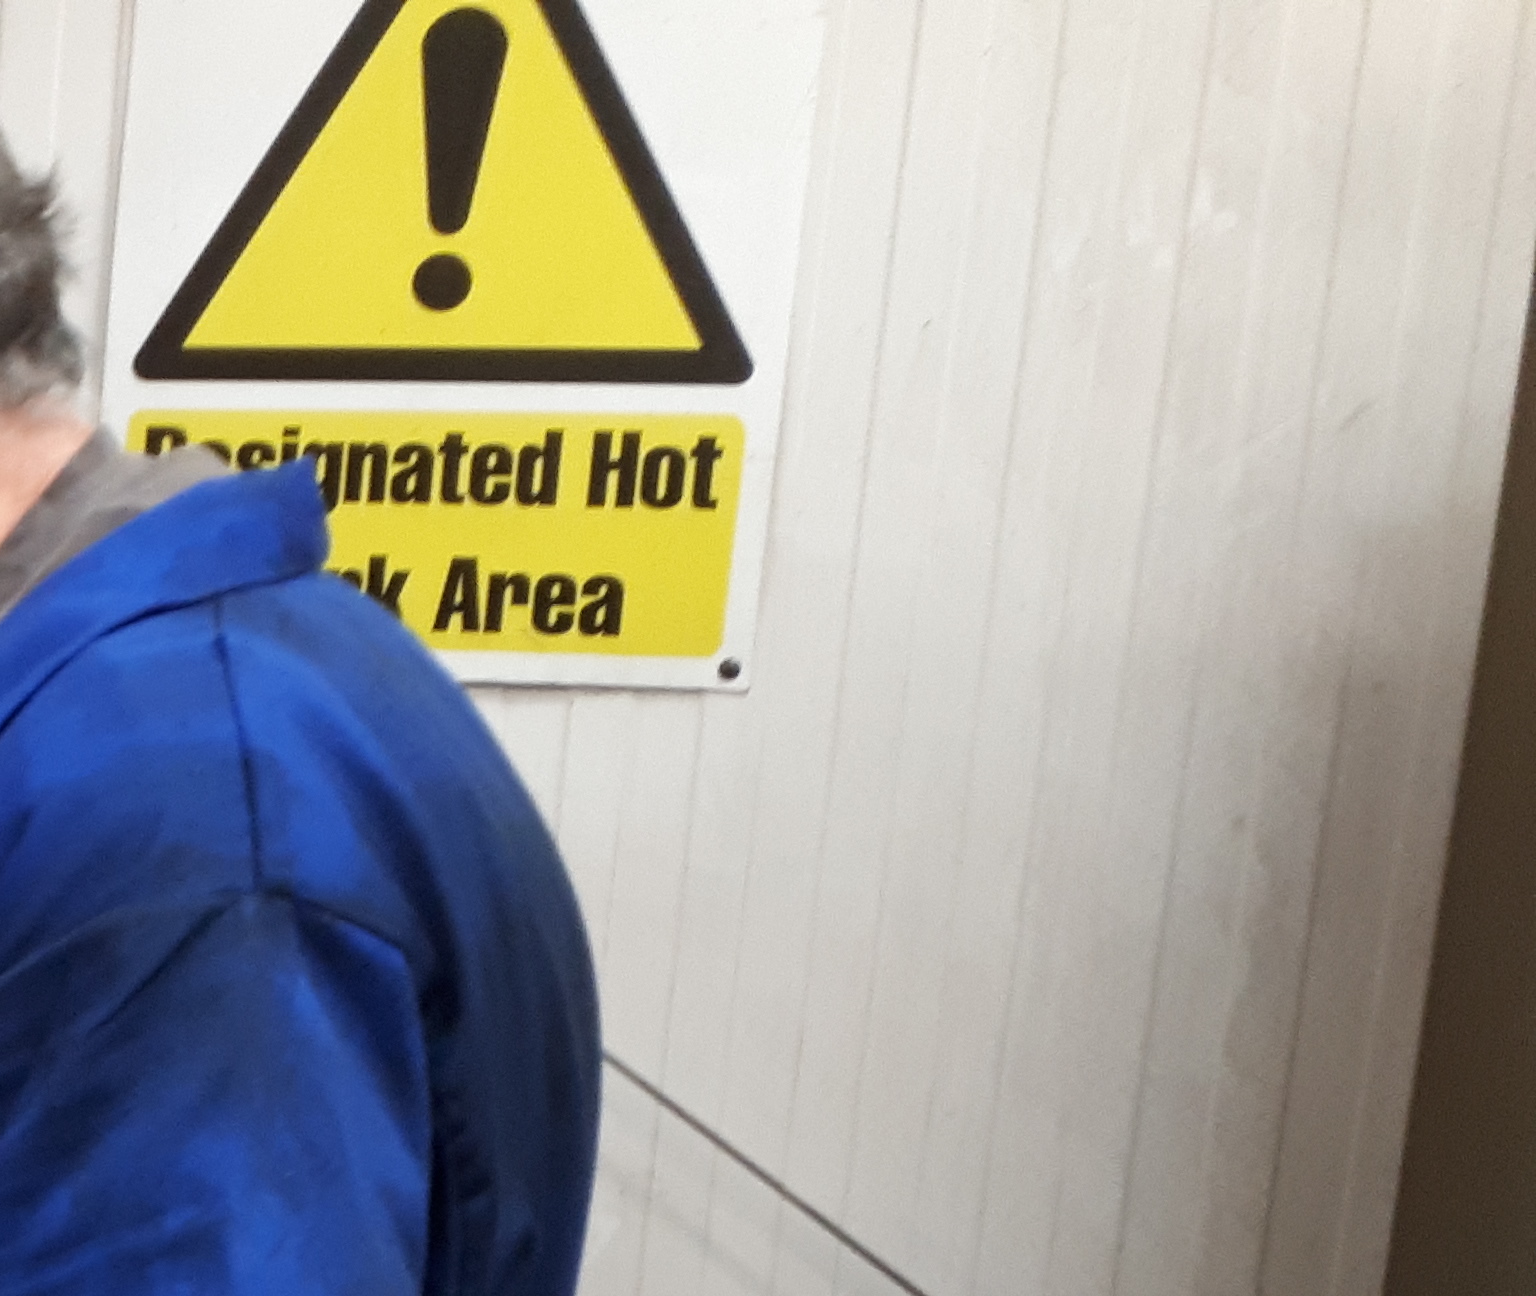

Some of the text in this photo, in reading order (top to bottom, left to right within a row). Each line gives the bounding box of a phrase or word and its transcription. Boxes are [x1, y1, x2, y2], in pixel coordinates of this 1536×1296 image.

[145, 426, 724, 513] signated Hot
[431, 555, 627, 637] Area
